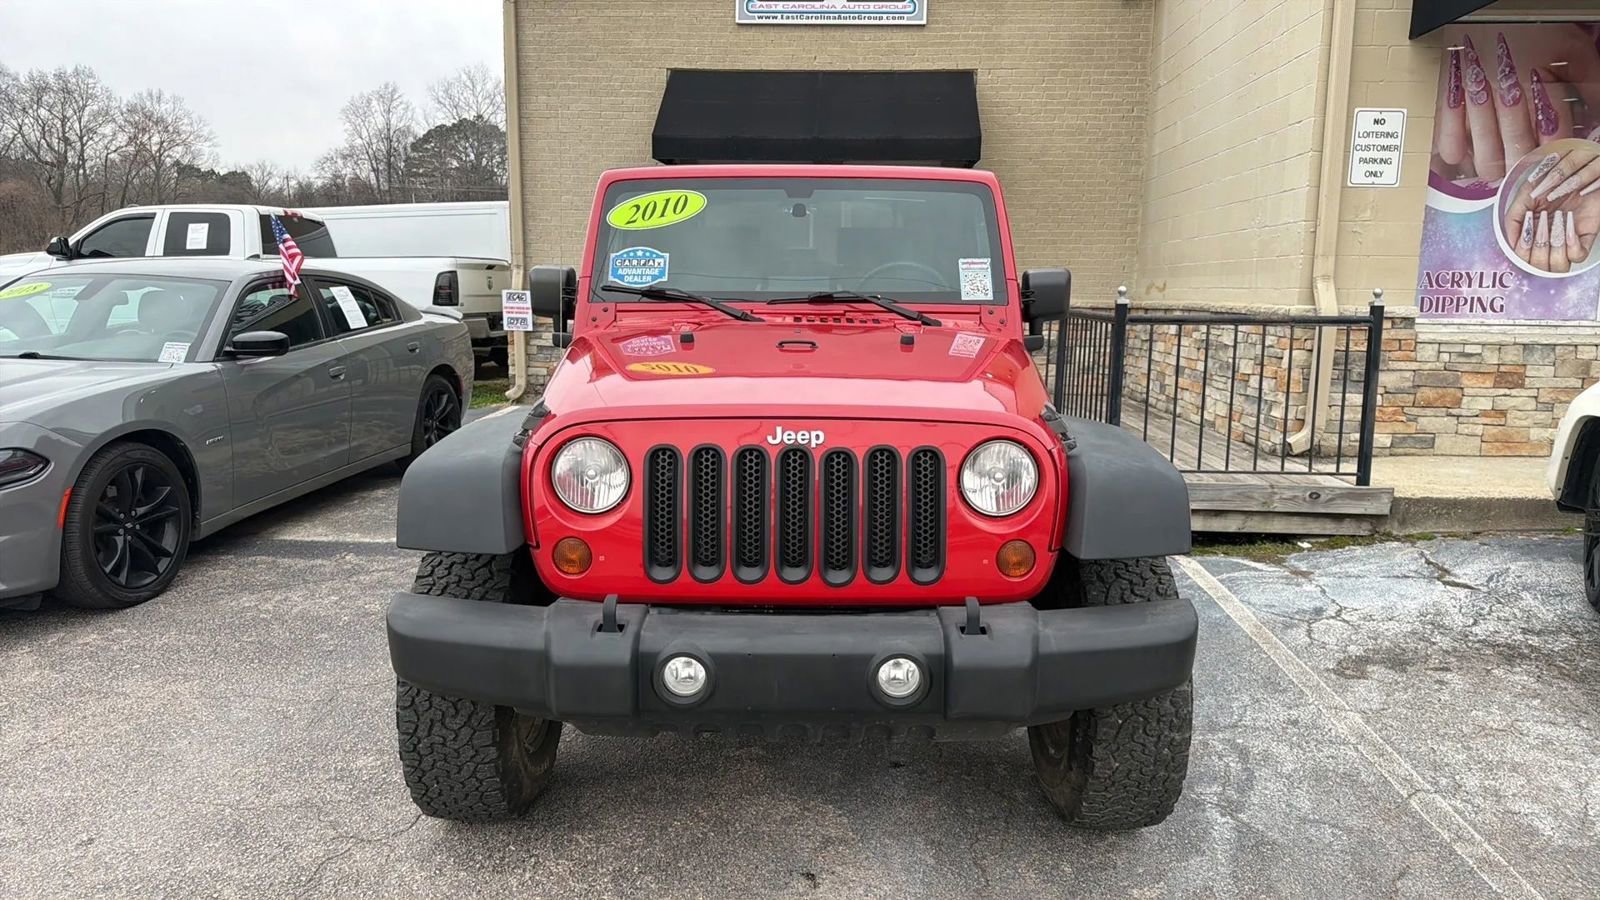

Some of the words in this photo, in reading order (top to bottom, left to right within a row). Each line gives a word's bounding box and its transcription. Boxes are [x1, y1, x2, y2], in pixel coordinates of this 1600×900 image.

[1373, 118, 1386, 126] NO
[1357, 131, 1399, 139] LOITERING
[1355, 144, 1399, 152] CUSTOMER
[1358, 157, 1392, 165] PARKING
[1364, 170, 1384, 178] ONLY
[624, 194, 688, 225] 2010
[1420, 271, 1513, 289] ACRYLIC
[1419, 296, 1505, 313] DIPPING
[766, 425, 825, 448] Jeep
